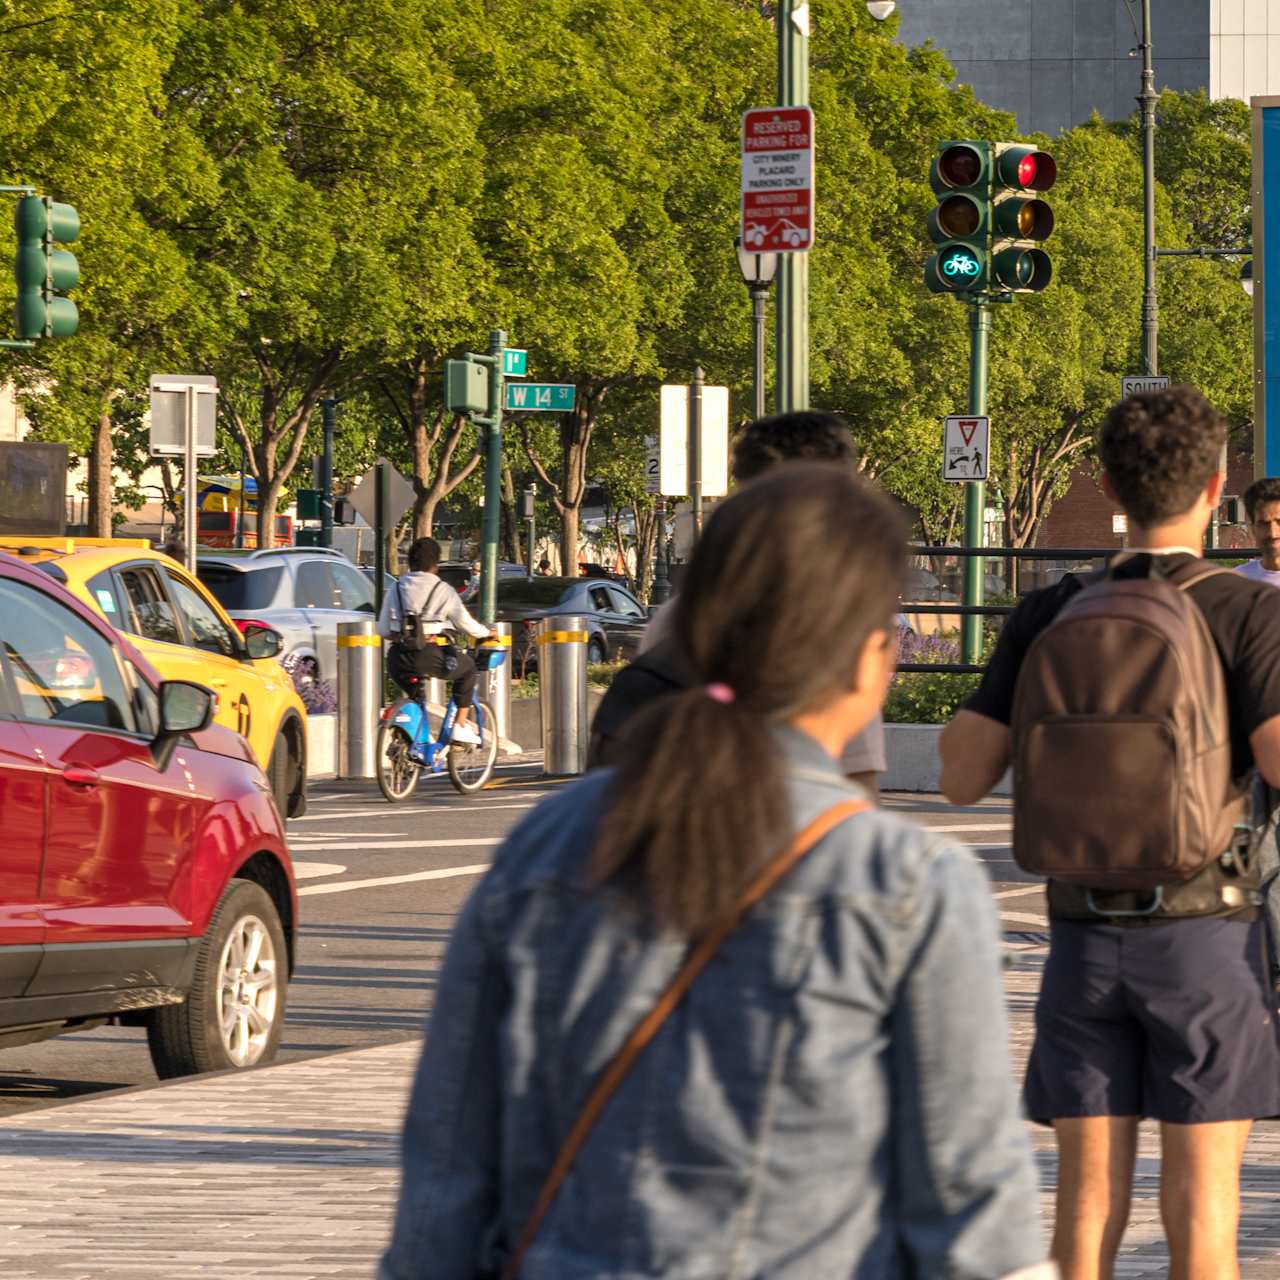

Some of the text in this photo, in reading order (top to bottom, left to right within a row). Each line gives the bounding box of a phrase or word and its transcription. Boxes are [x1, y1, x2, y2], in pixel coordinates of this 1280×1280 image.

[753, 120, 801, 134] RESERVED
[746, 134, 808, 148] PARKING FOR
[753, 155, 770, 165] CITY
[758, 166, 796, 175] PLACARD
[749, 178, 805, 188] PARKING ONLY
[513, 387, 569, 407] W 14 ST
